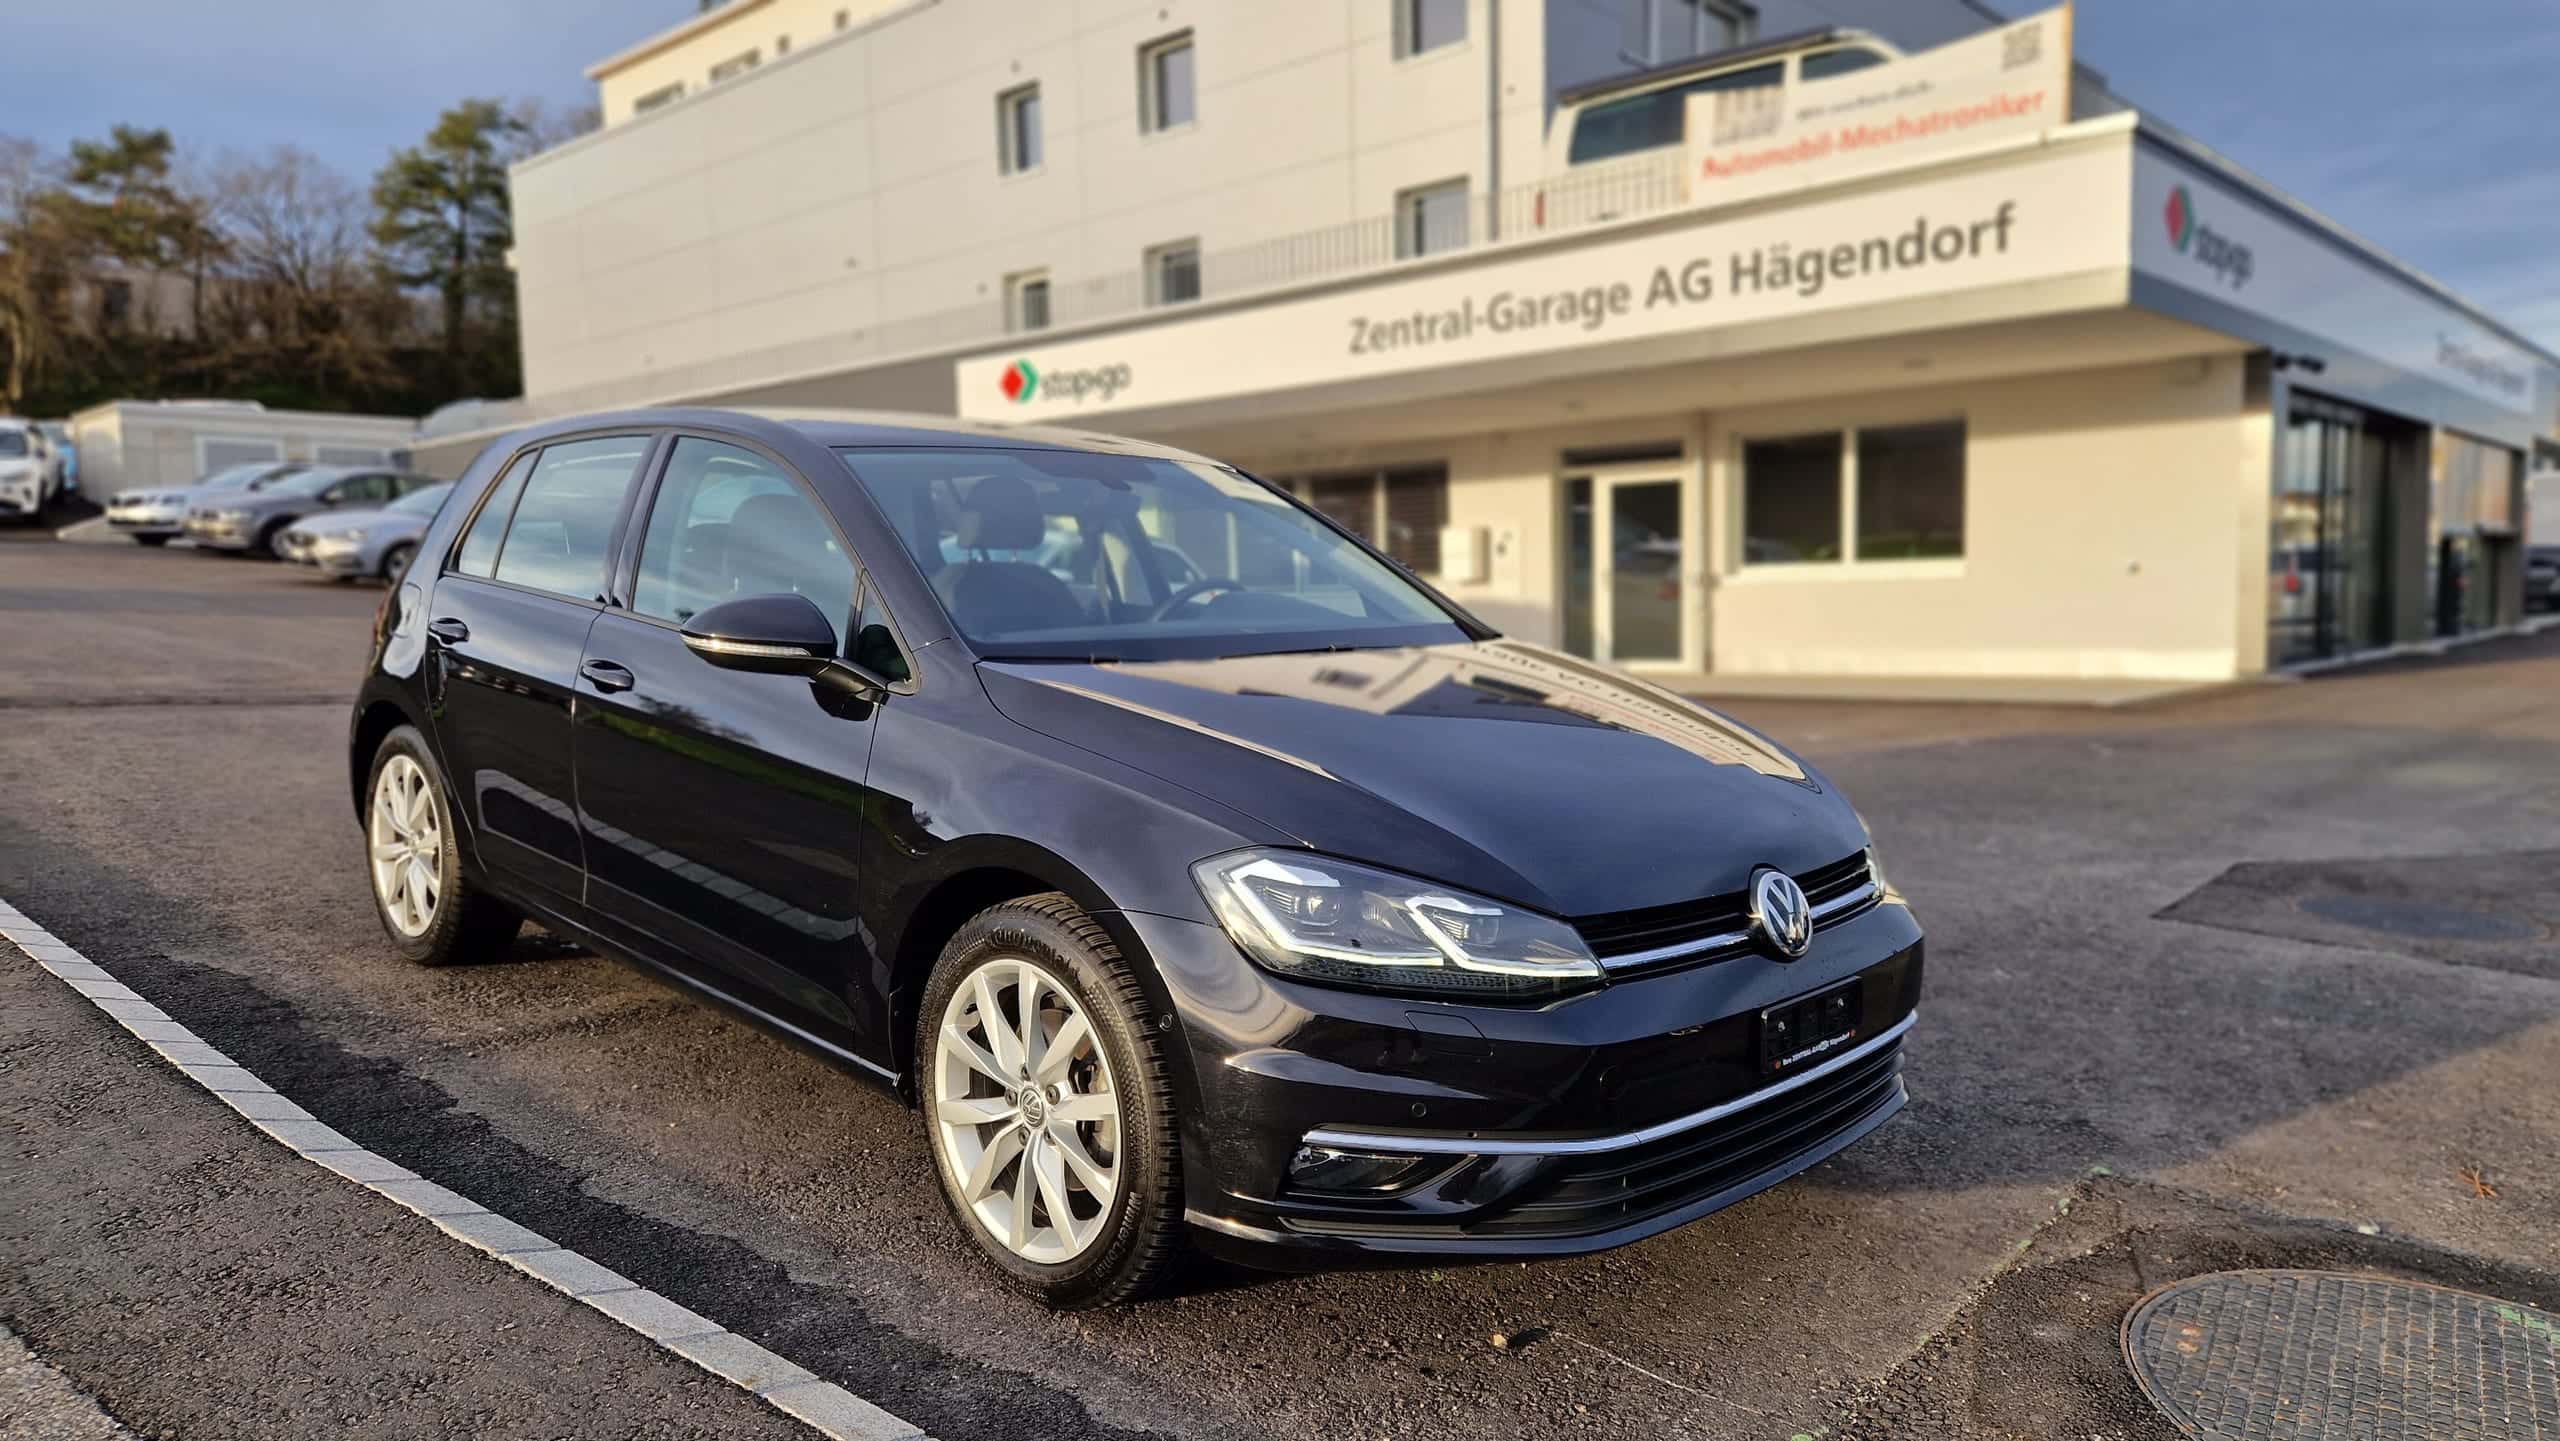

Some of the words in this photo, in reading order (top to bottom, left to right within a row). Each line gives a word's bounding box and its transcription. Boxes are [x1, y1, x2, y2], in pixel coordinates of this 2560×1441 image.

[1348, 281, 1632, 355] Zentral-Garage
[1644, 257, 1713, 309] AG
[1729, 199, 2016, 297] Hägendorf
